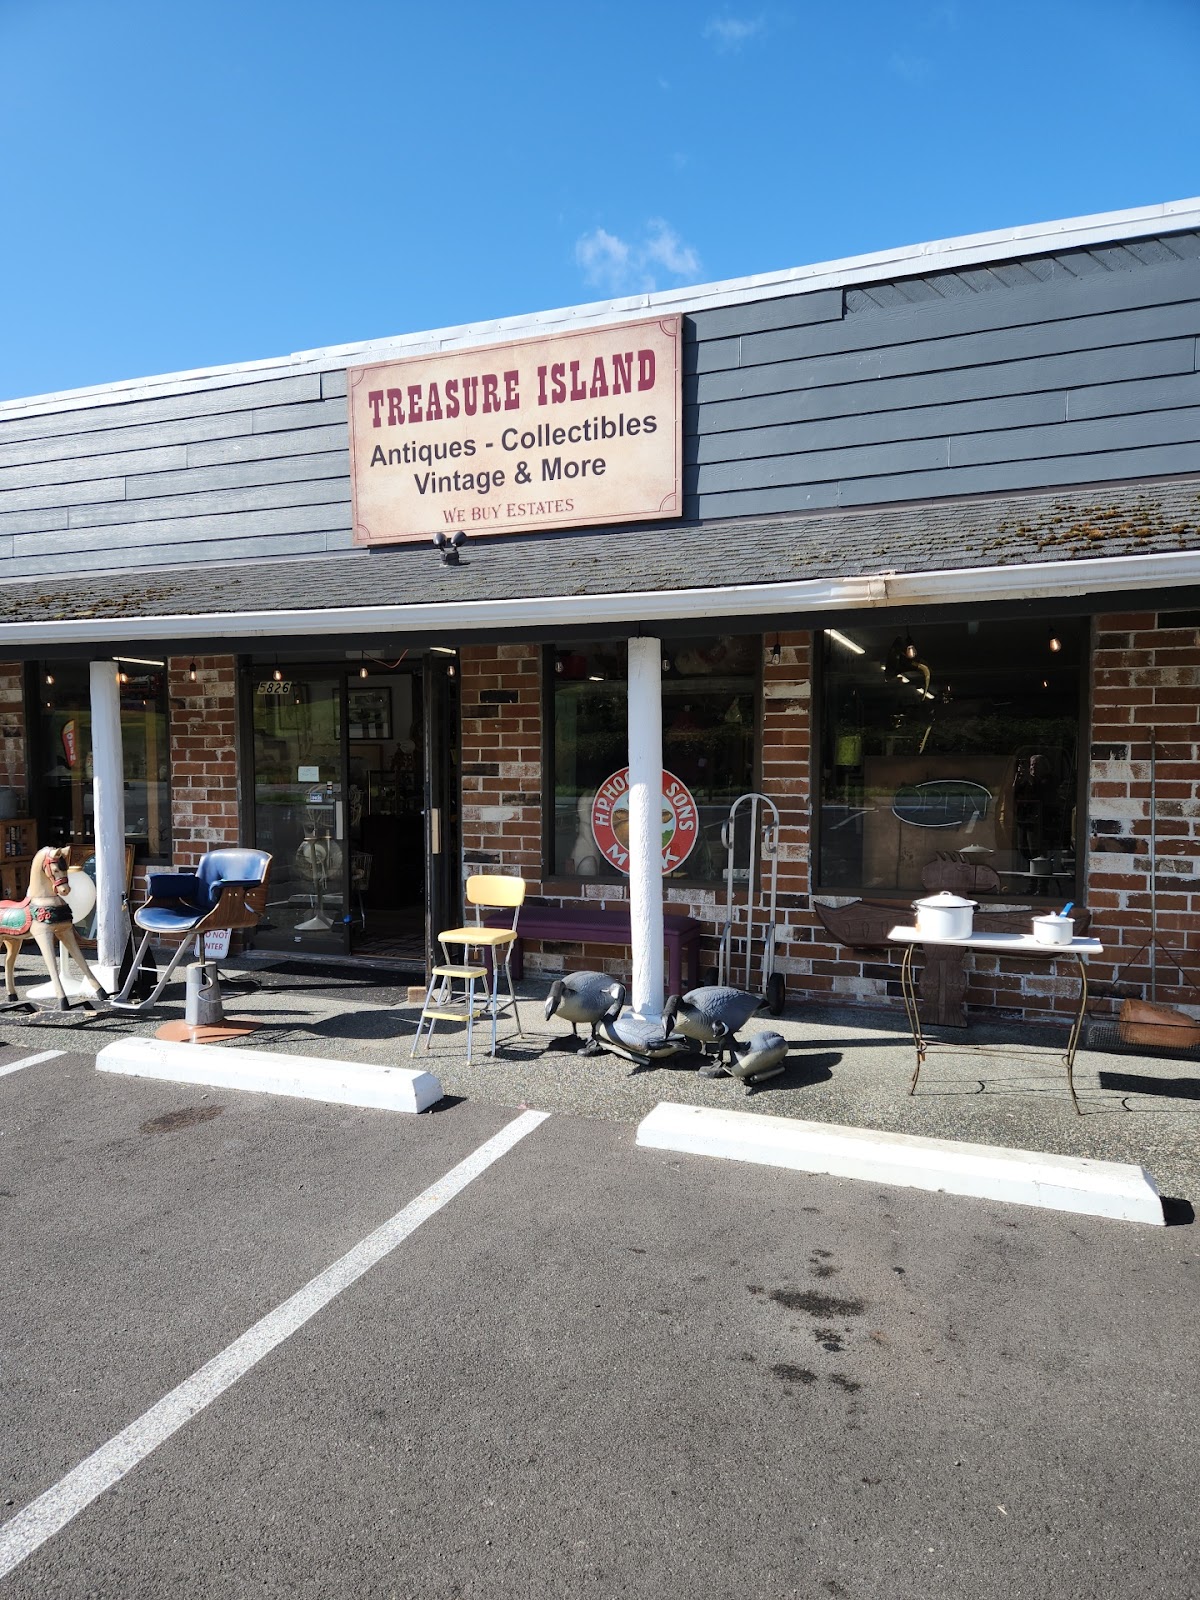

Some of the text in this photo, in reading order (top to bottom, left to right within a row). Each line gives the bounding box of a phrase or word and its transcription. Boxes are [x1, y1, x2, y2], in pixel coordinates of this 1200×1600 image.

[368, 349, 656, 428] TREASURE ISLAND
[370, 438, 476, 468] Antiques
[501, 413, 657, 452] Collectibles
[414, 457, 606, 495] Vintage & More
[443, 498, 575, 523] WE BUY ESTATES
[260, 682, 290, 694] 5826
[666, 783, 694, 831] SONS
[204, 942, 223, 951] NTER
